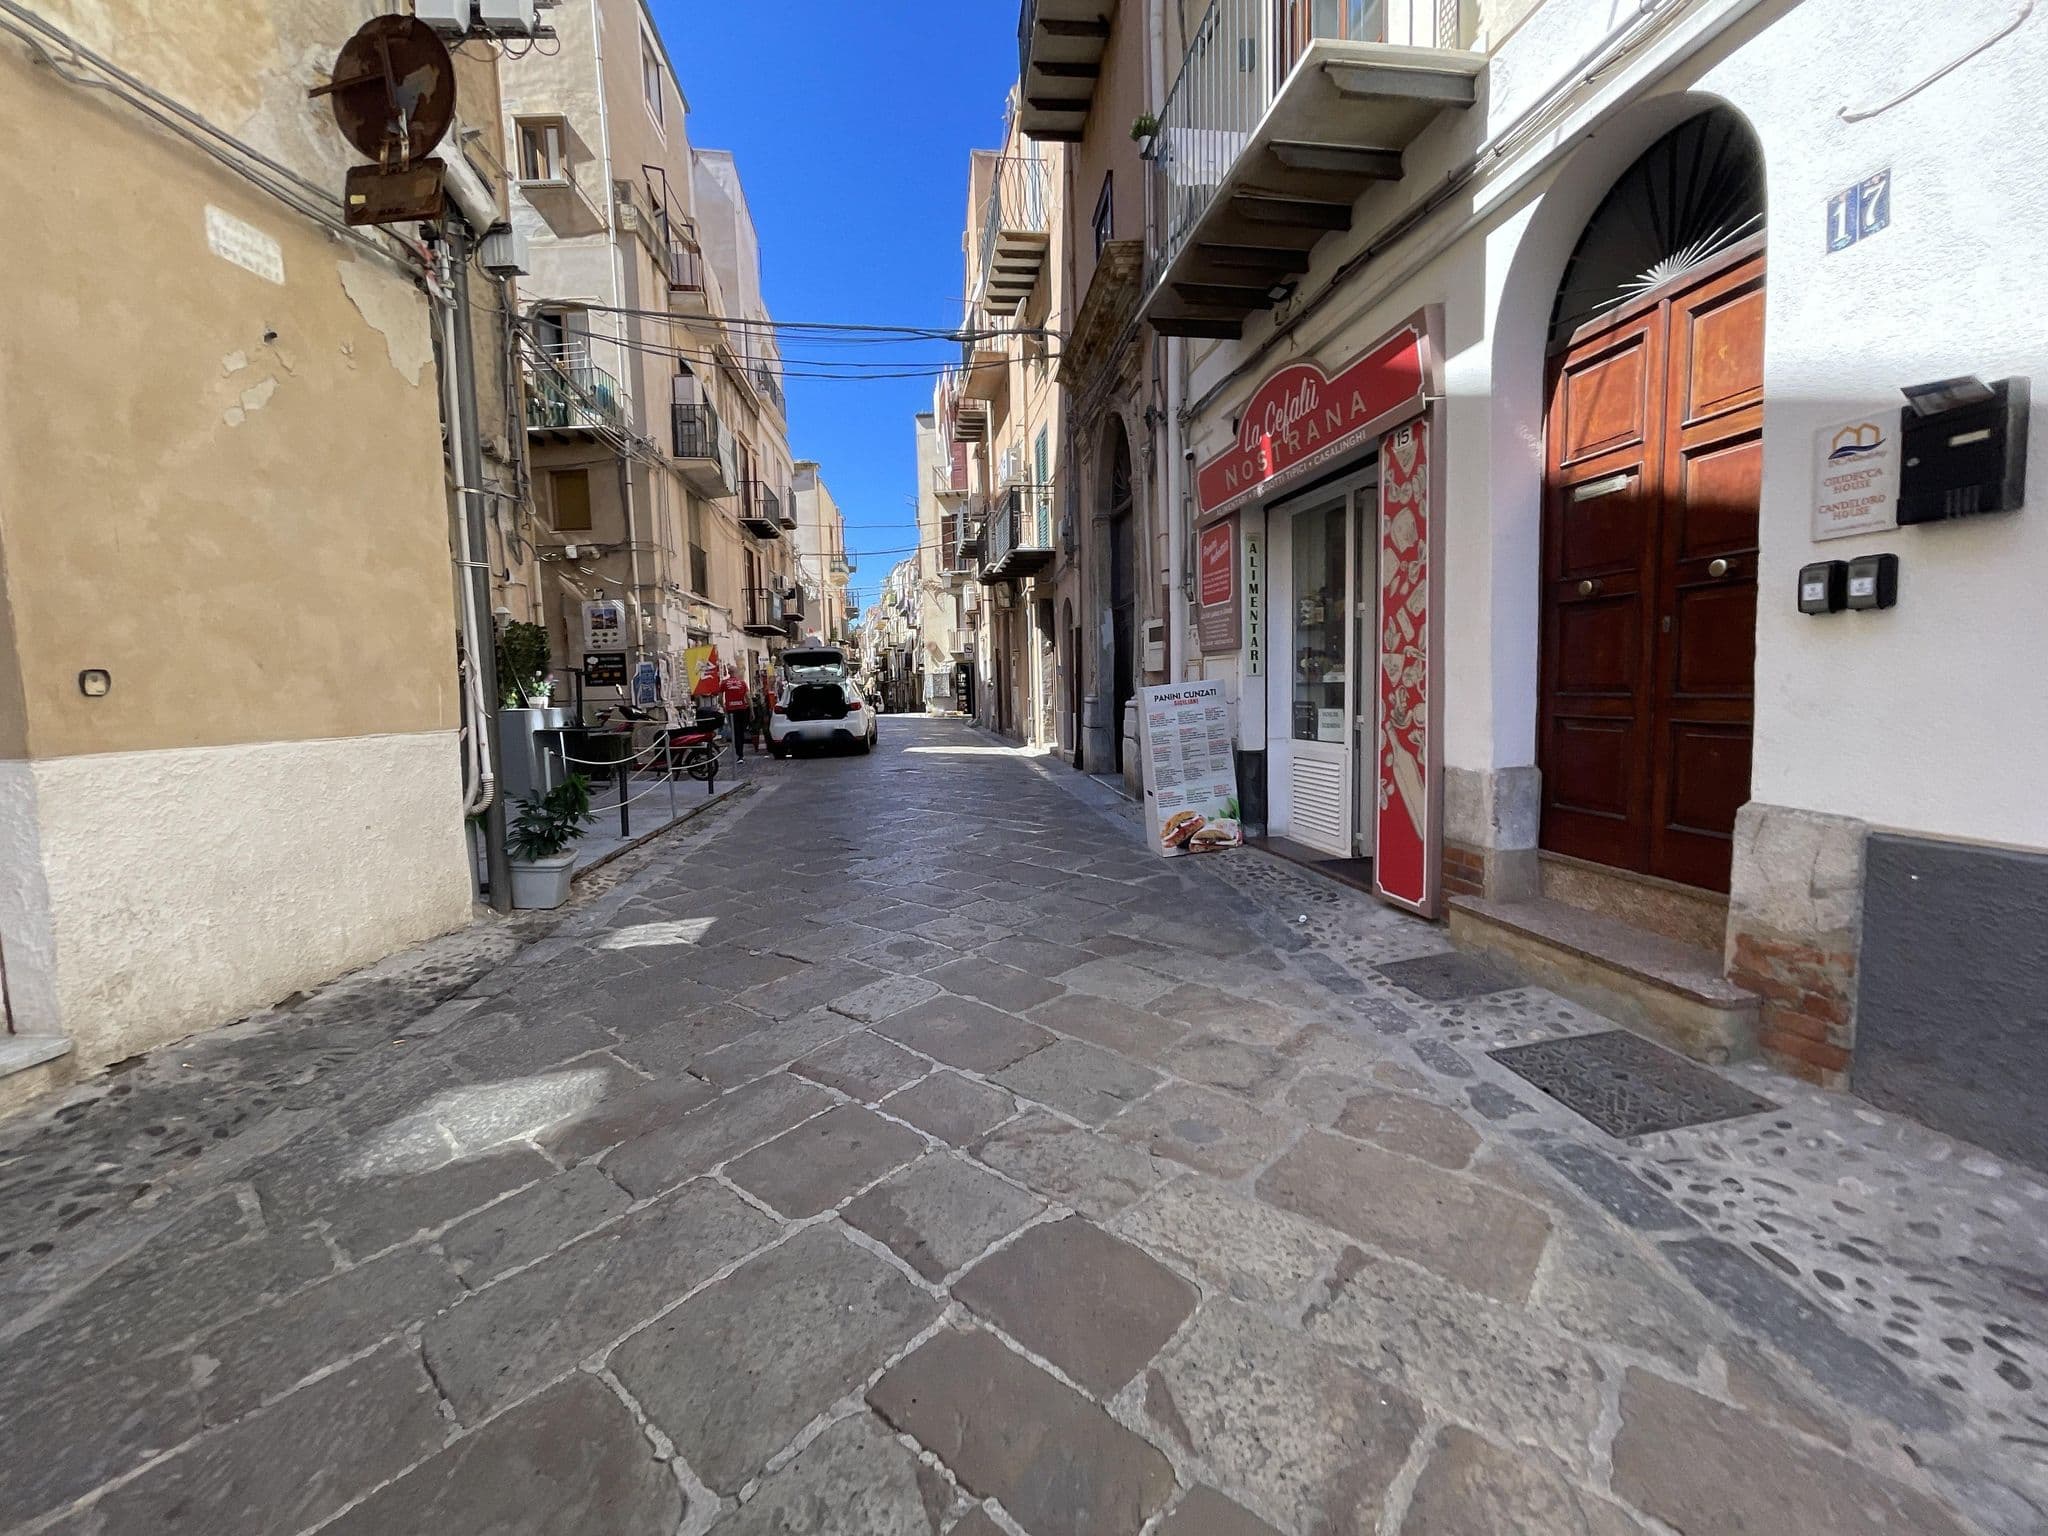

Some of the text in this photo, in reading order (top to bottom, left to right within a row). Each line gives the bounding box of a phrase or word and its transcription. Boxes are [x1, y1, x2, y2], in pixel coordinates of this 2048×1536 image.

[1832, 180, 1887, 241] 17
[1244, 377, 1319, 453] La Cefalù
[1395, 429, 1409, 447] 15
[1225, 391, 1367, 491] NOSTRANA
[1285, 461, 1307, 478] TIPICI
[1313, 430, 1366, 466] CASALINGHI
[1832, 480, 1872, 494] HOUSE
[1832, 506, 1872, 521] HOUSE
[1248, 543, 1259, 674] ALIMENTARI
[1154, 688, 1217, 702] PANINI CUNZATI
